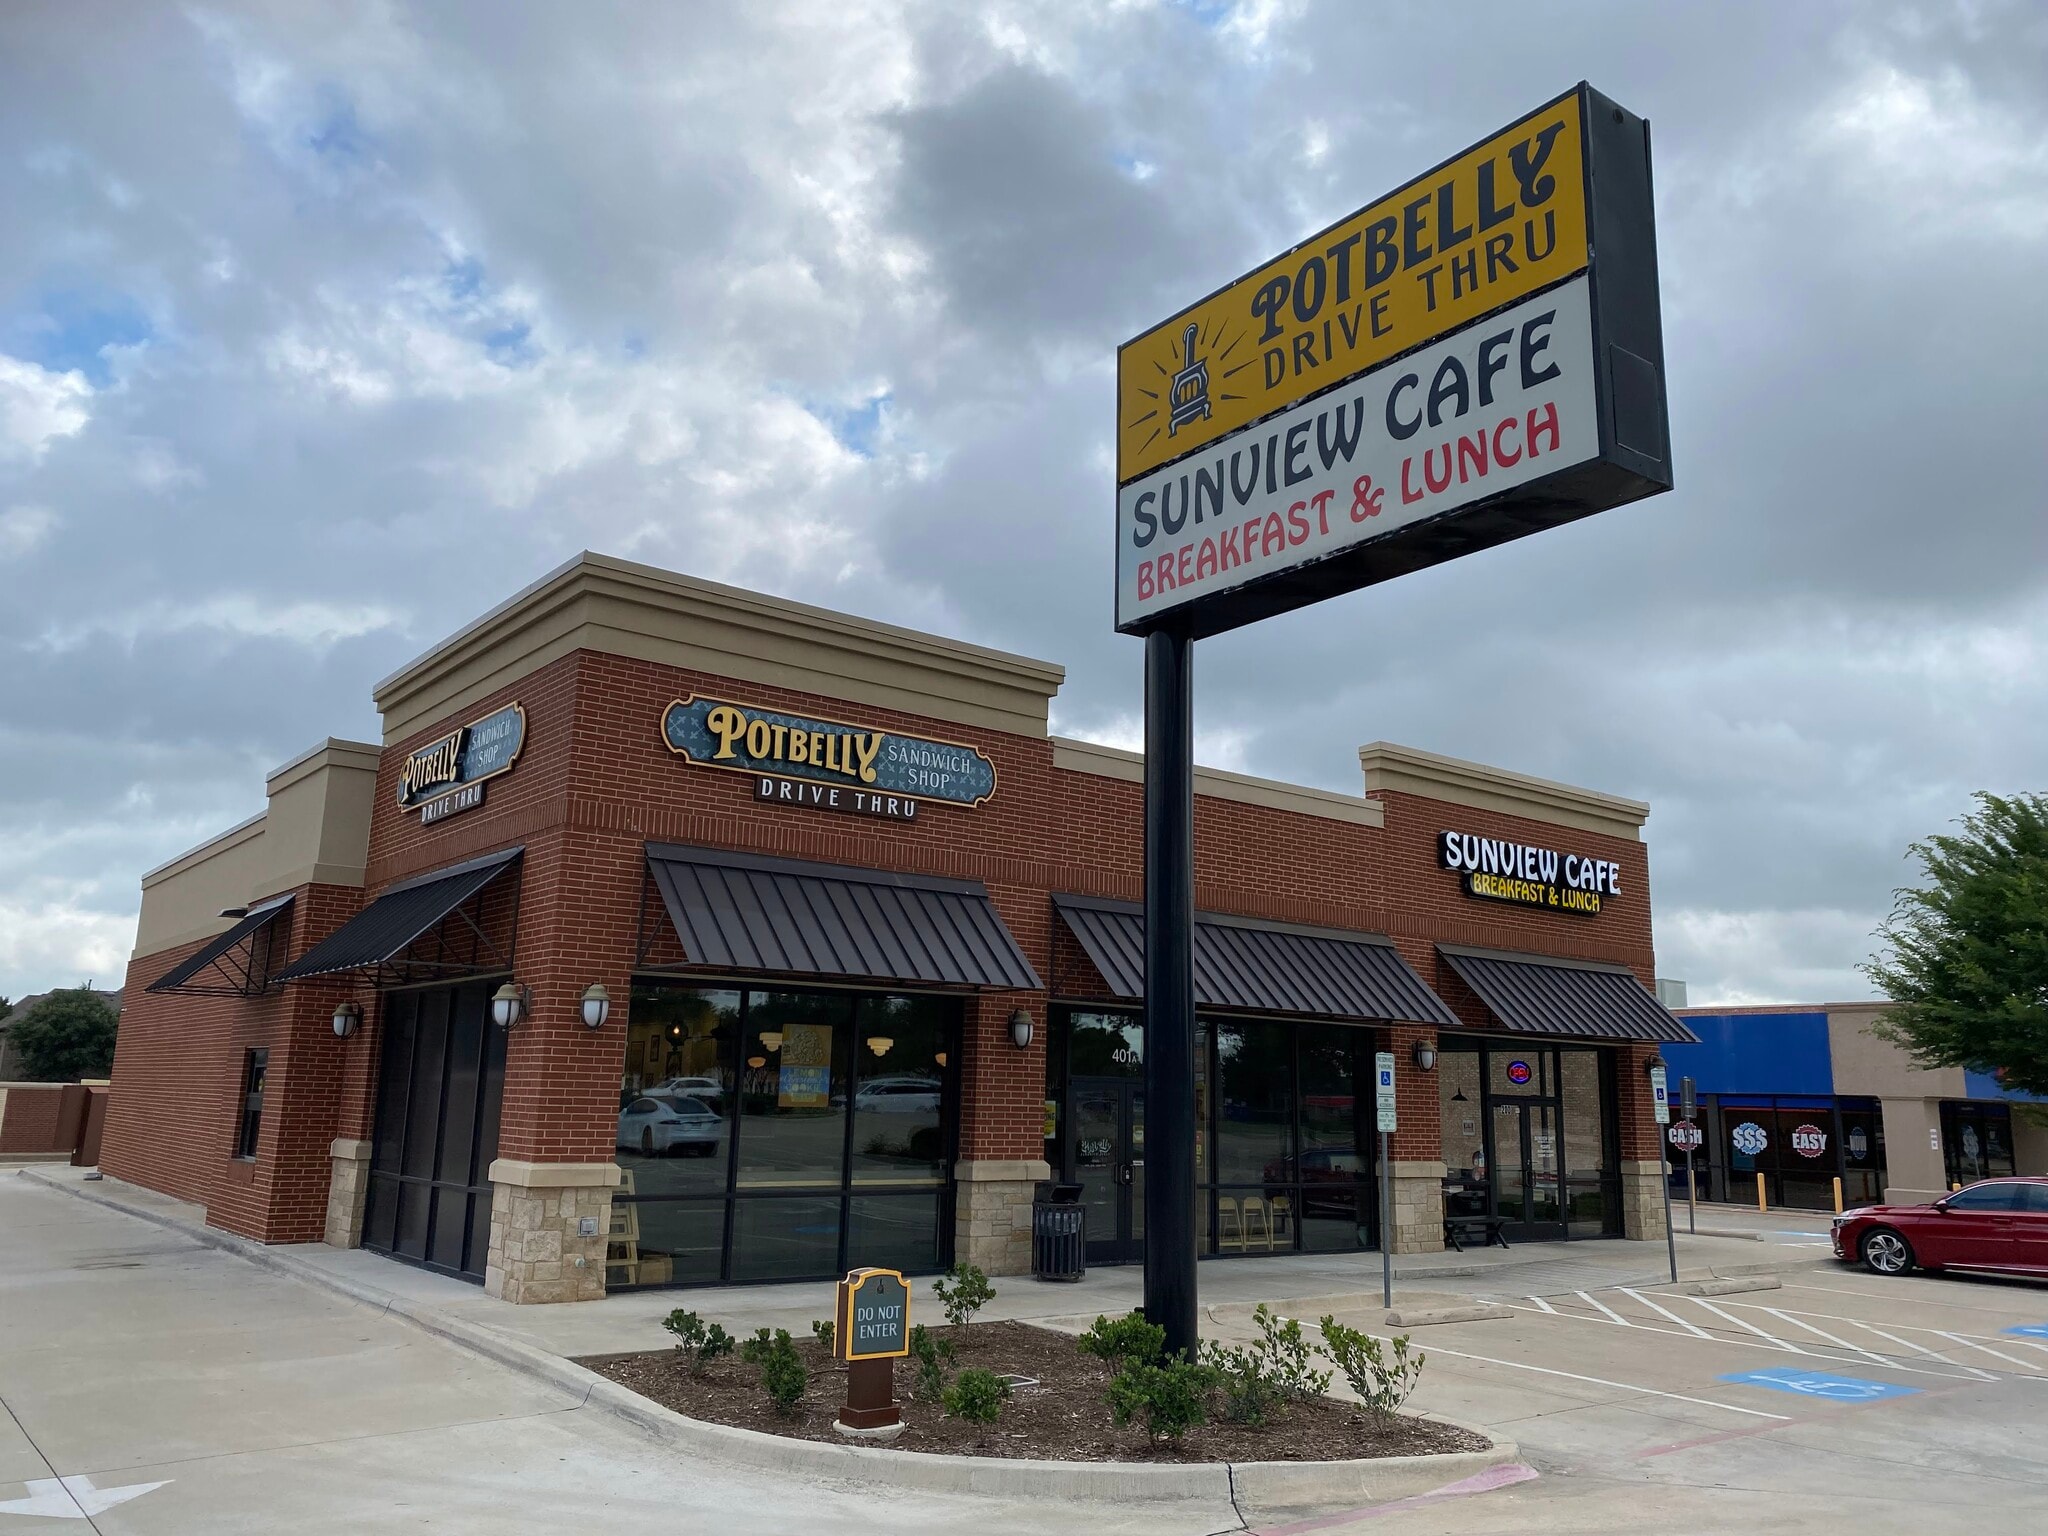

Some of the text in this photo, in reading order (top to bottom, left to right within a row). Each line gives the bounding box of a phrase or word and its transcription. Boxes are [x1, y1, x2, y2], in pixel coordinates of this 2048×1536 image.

[1251, 120, 1565, 345] POTBELLY
[1263, 209, 1556, 391] DRIVE THRU
[1133, 308, 1562, 548] SUNVIEW CAFE
[1137, 401, 1561, 601] BREAKFAST & LUNCH
[471, 718, 511, 752] SANDWICH
[708, 706, 885, 783] POTBELLY
[402, 731, 464, 802] POTBELLY
[477, 747, 498, 769] SHOP
[887, 744, 972, 775] SANDWICH
[908, 766, 951, 789] SHOP
[421, 785, 481, 823] DRIVE THRU
[761, 779, 917, 818] DRIVE THRU
[1445, 830, 1622, 896] SUNVIEW CAFE
[1472, 872, 1601, 913] BREAKFAST & LUNCH
[1792, 1133, 1828, 1150] EASY
[857, 1305, 901, 1322] DO NOT
[860, 1322, 897, 1339] ENTER
